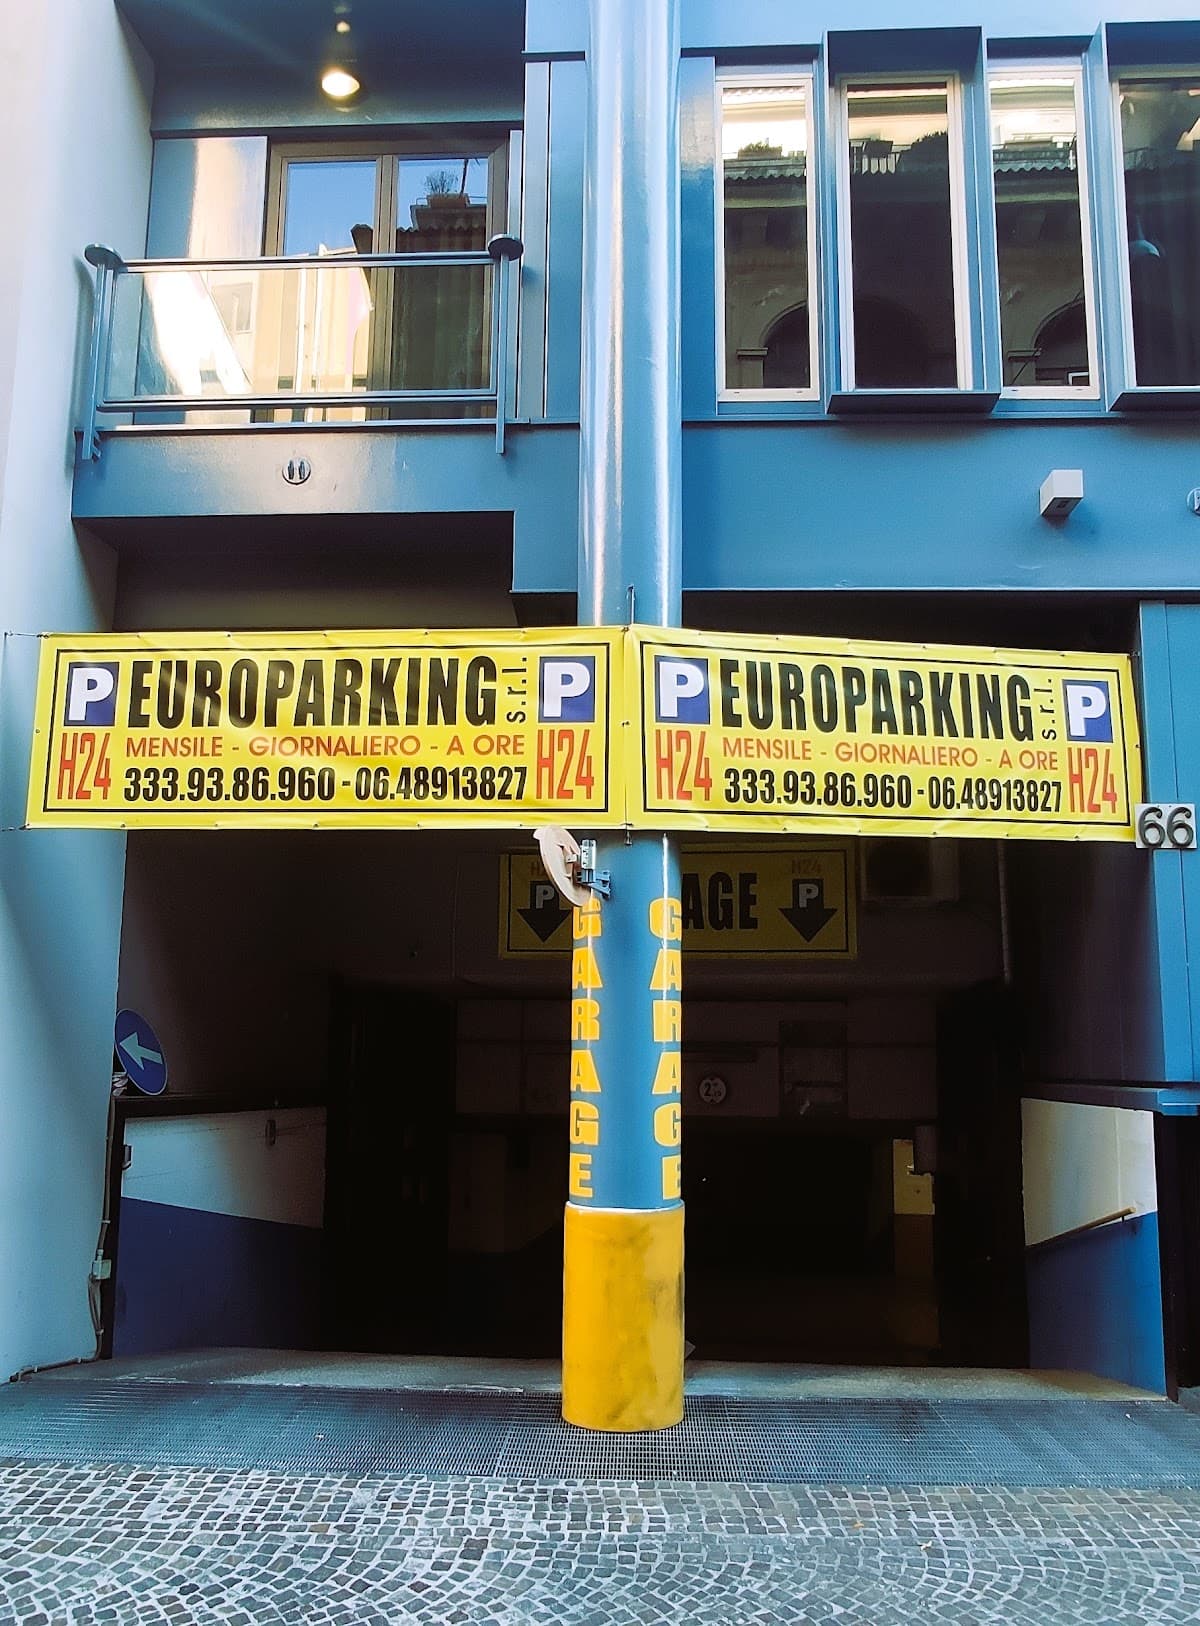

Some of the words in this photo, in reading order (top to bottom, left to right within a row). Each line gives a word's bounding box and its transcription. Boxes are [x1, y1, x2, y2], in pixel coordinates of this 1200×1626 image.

[68, 667, 114, 721] P
[128, 656, 497, 729] EUROPARKING
[501, 656, 528, 723] s.r.l.
[543, 662, 591, 718] P
[658, 661, 705, 718] P
[719, 658, 1034, 742] EUROPARKING
[1033, 678, 1057, 741] s.r.l.
[1066, 685, 1107, 737] P
[57, 732, 111, 800] H24
[126, 736, 223, 758] MENSILE
[249, 735, 421, 757] GIORNALIERO
[446, 735, 465, 756] A
[473, 734, 525, 756] ORE
[535, 729, 595, 800] H24
[655, 729, 713, 801] H24
[722, 736, 812, 761] MENSILE
[834, 741, 978, 768] GIORNALIERO
[998, 749, 1013, 769] A
[1018, 749, 1058, 770] ORE
[1066, 747, 1118, 814] H24
[1138, 806, 1194, 847] 66
[535, 884, 555, 910] P
[681, 871, 758, 931] AGE
[798, 883, 820, 909] P
[569, 893, 603, 1198] GARAGE
